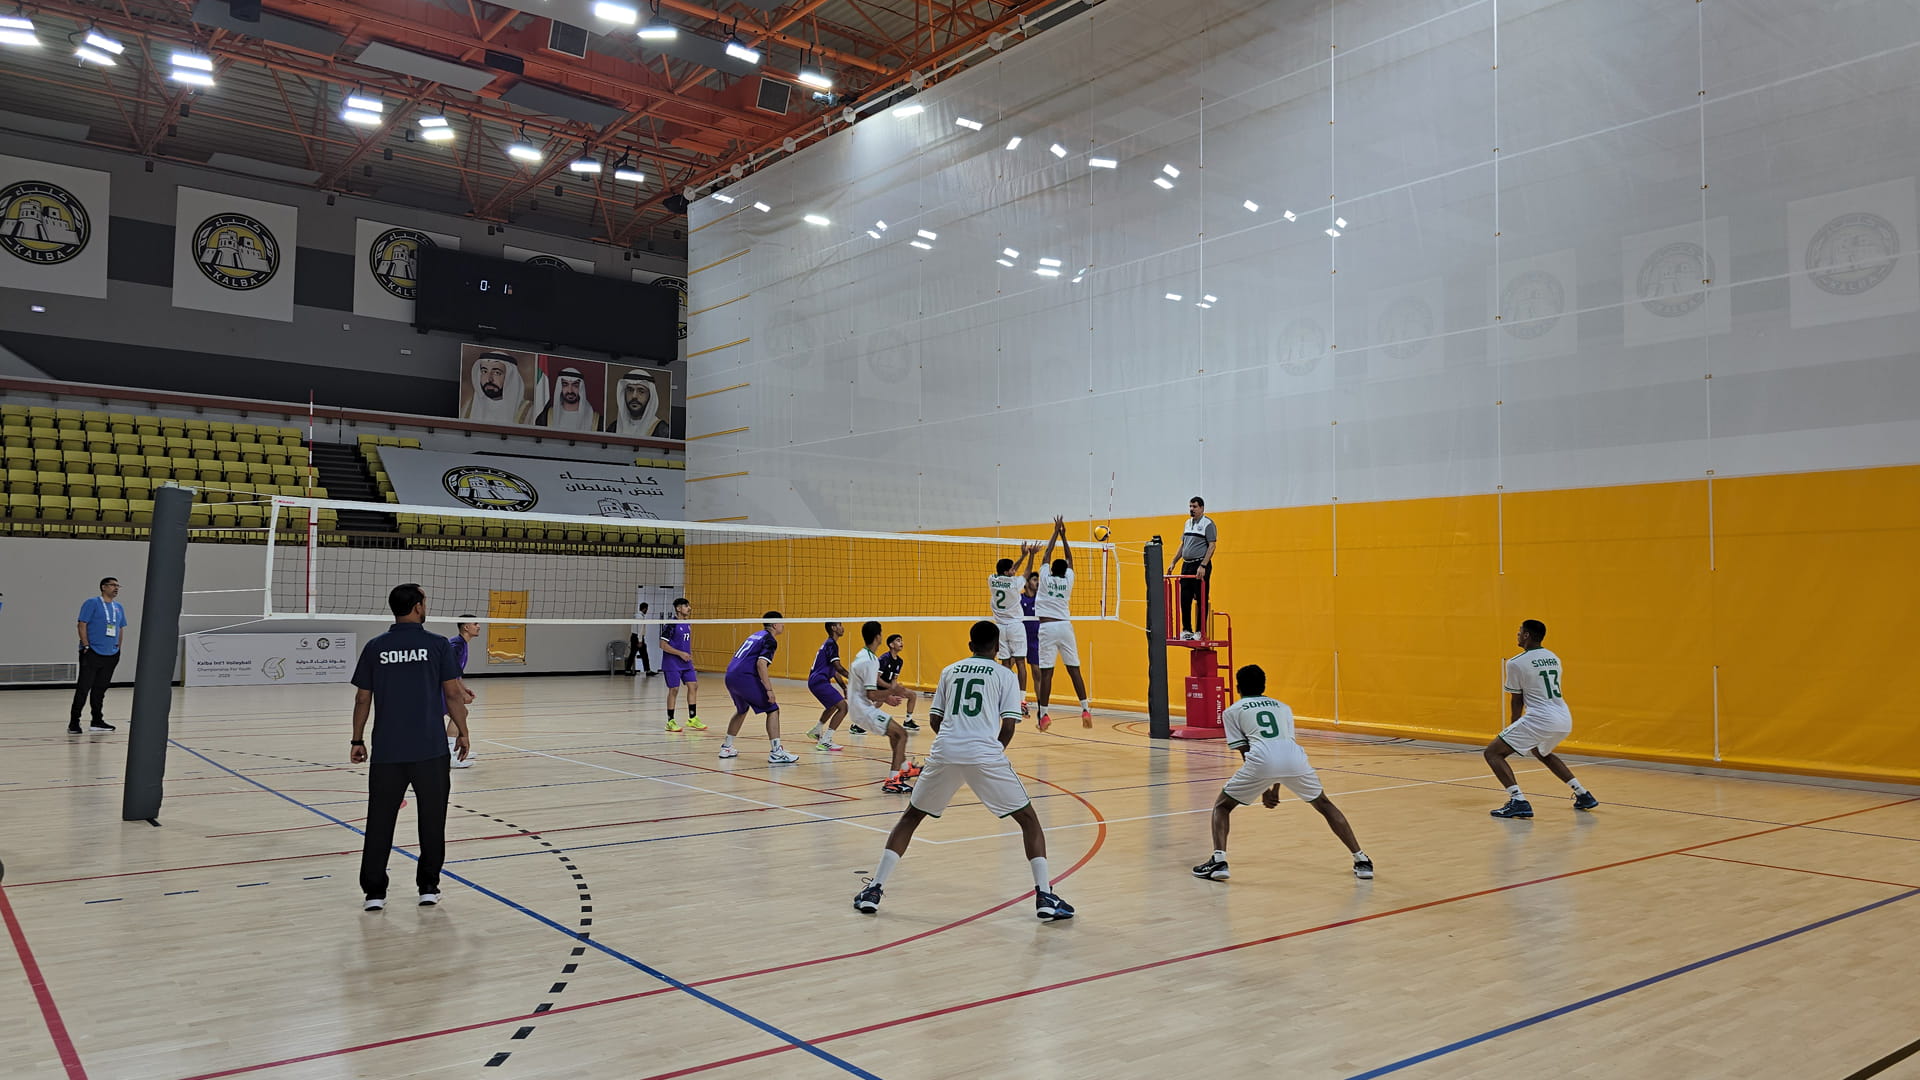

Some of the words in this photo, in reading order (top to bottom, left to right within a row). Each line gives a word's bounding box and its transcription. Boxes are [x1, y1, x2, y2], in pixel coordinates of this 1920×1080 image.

[14, 245, 66, 261] KALBA
[213, 271, 258, 287] KALBA
[992, 581, 1011, 589] SOHAR
[996, 590, 1006, 609] 2
[380, 648, 428, 665] SOHAR
[953, 664, 994, 676] SOHAR
[1539, 669, 1562, 699] 13
[952, 677, 985, 717] 15
[1256, 711, 1279, 738] 9
